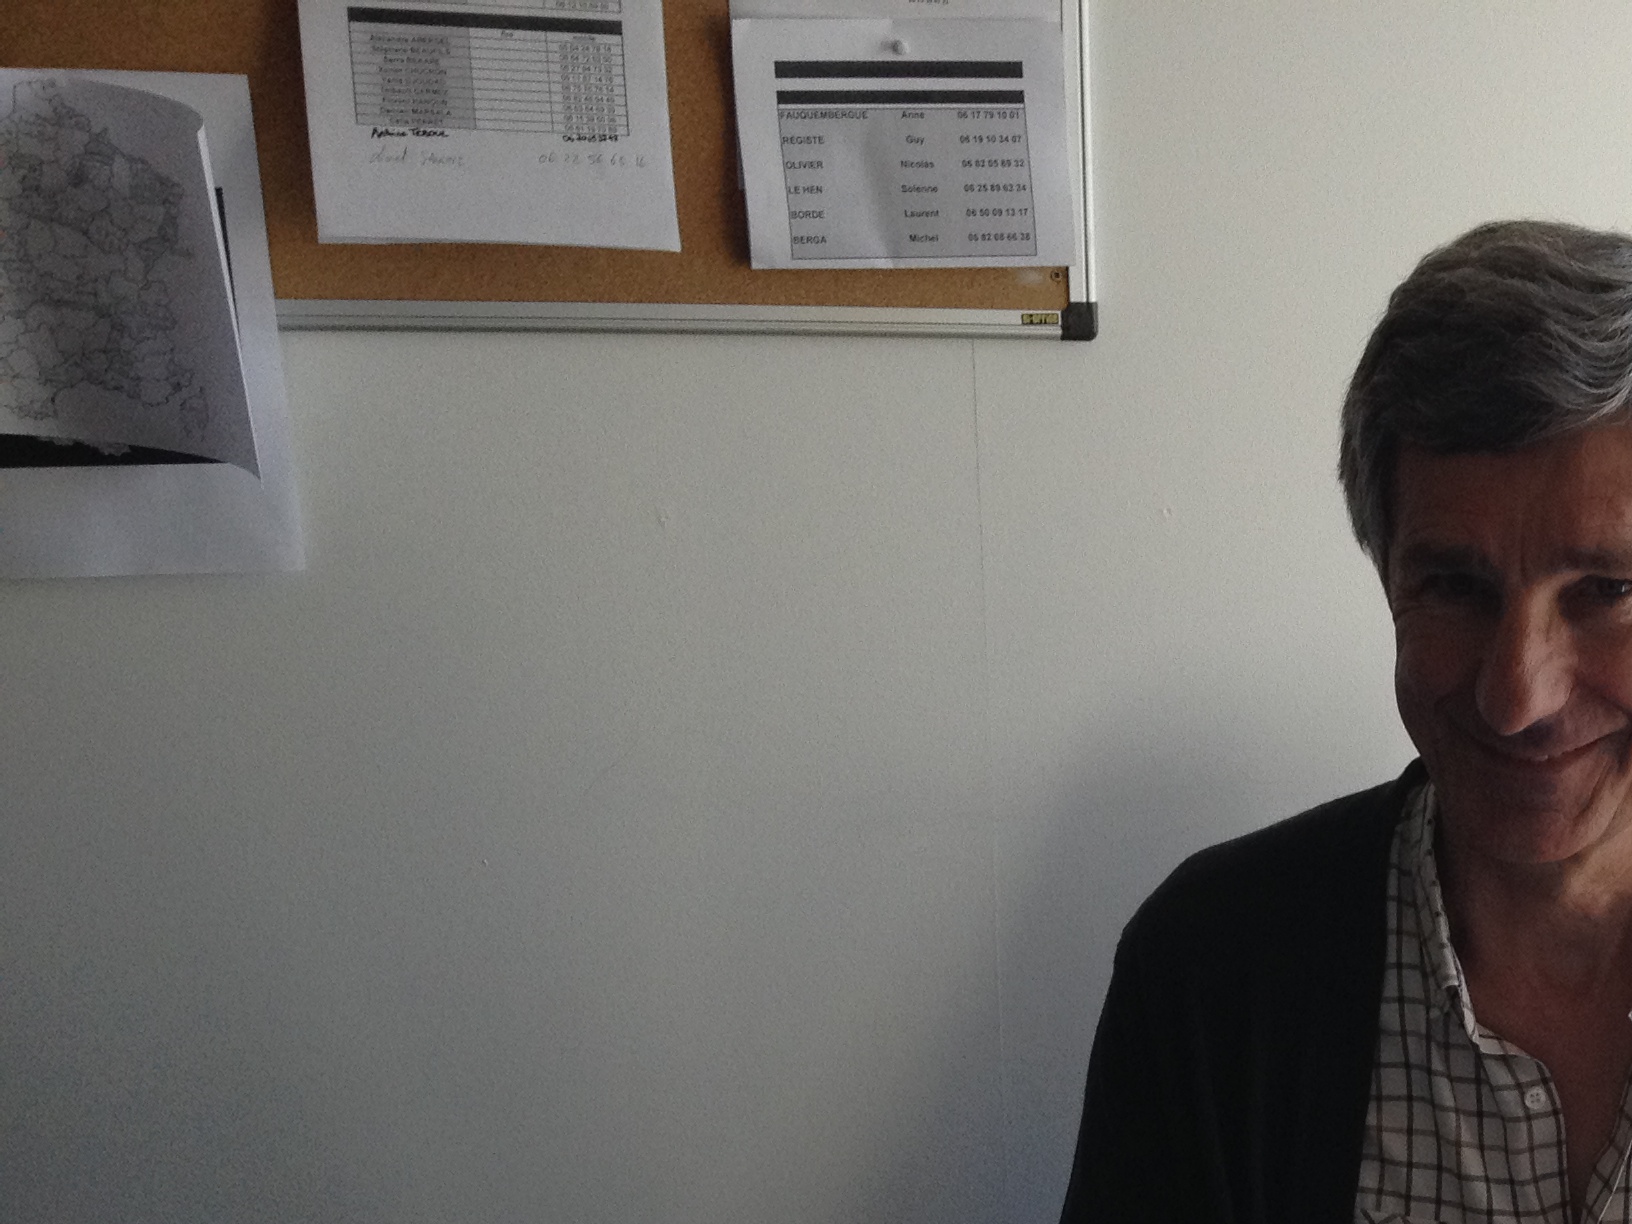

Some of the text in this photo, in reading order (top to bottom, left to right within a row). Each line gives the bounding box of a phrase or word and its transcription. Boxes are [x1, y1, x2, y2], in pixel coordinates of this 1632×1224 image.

[901, 111, 925, 119] Anne
[906, 135, 925, 145] Guy
[785, 160, 935, 169] OLIVIER Nicolas
[791, 209, 939, 219] BORDE Laurent
[909, 234, 939, 243] Michel
